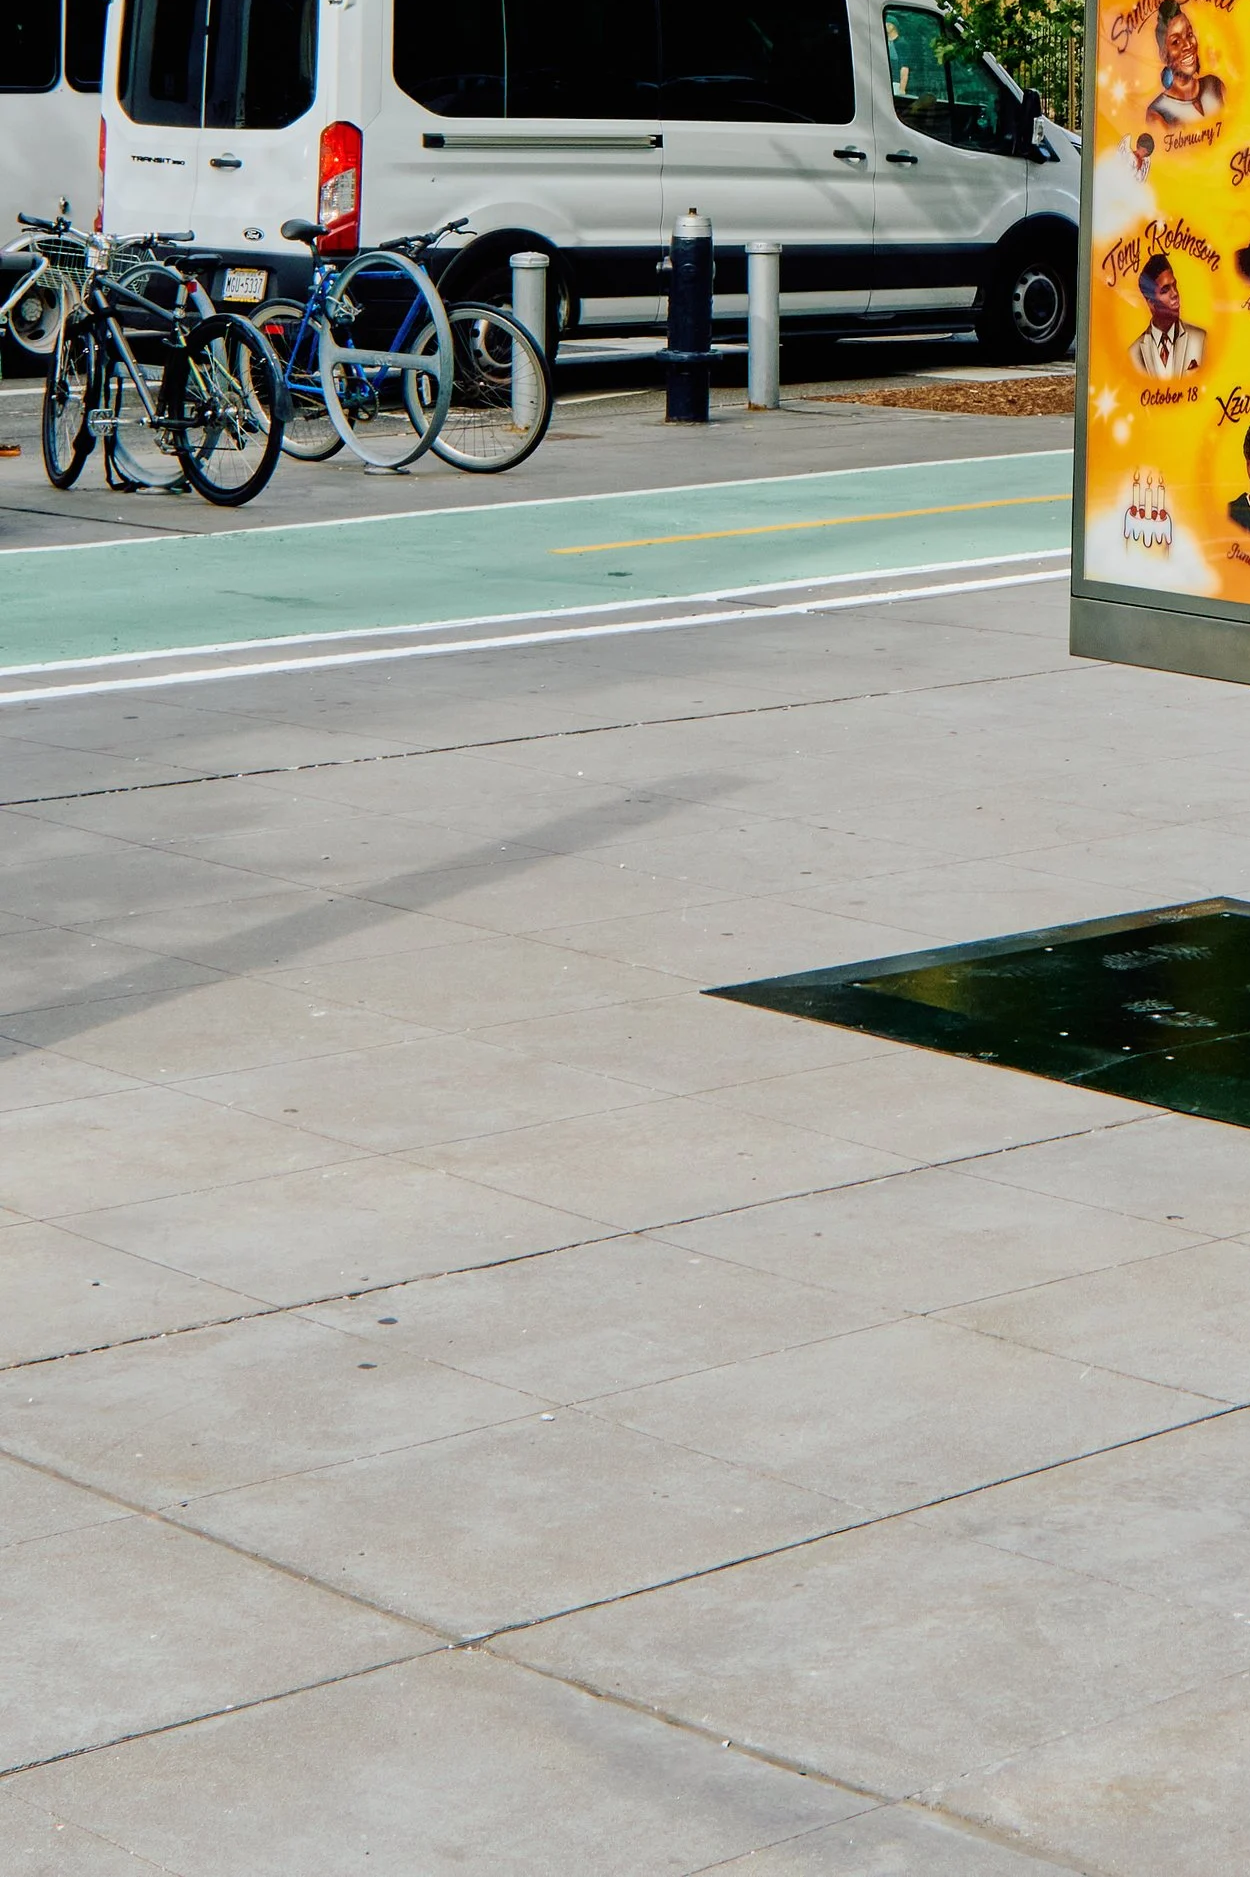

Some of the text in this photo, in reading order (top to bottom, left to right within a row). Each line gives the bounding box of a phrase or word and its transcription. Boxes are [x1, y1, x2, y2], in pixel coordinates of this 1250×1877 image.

[1164, 122, 1222, 152] February 7
[131, 155, 171, 164] TRANSIT
[1102, 218, 1221, 287] Tony Robinson
[1140, 387, 1198, 407] October 18
